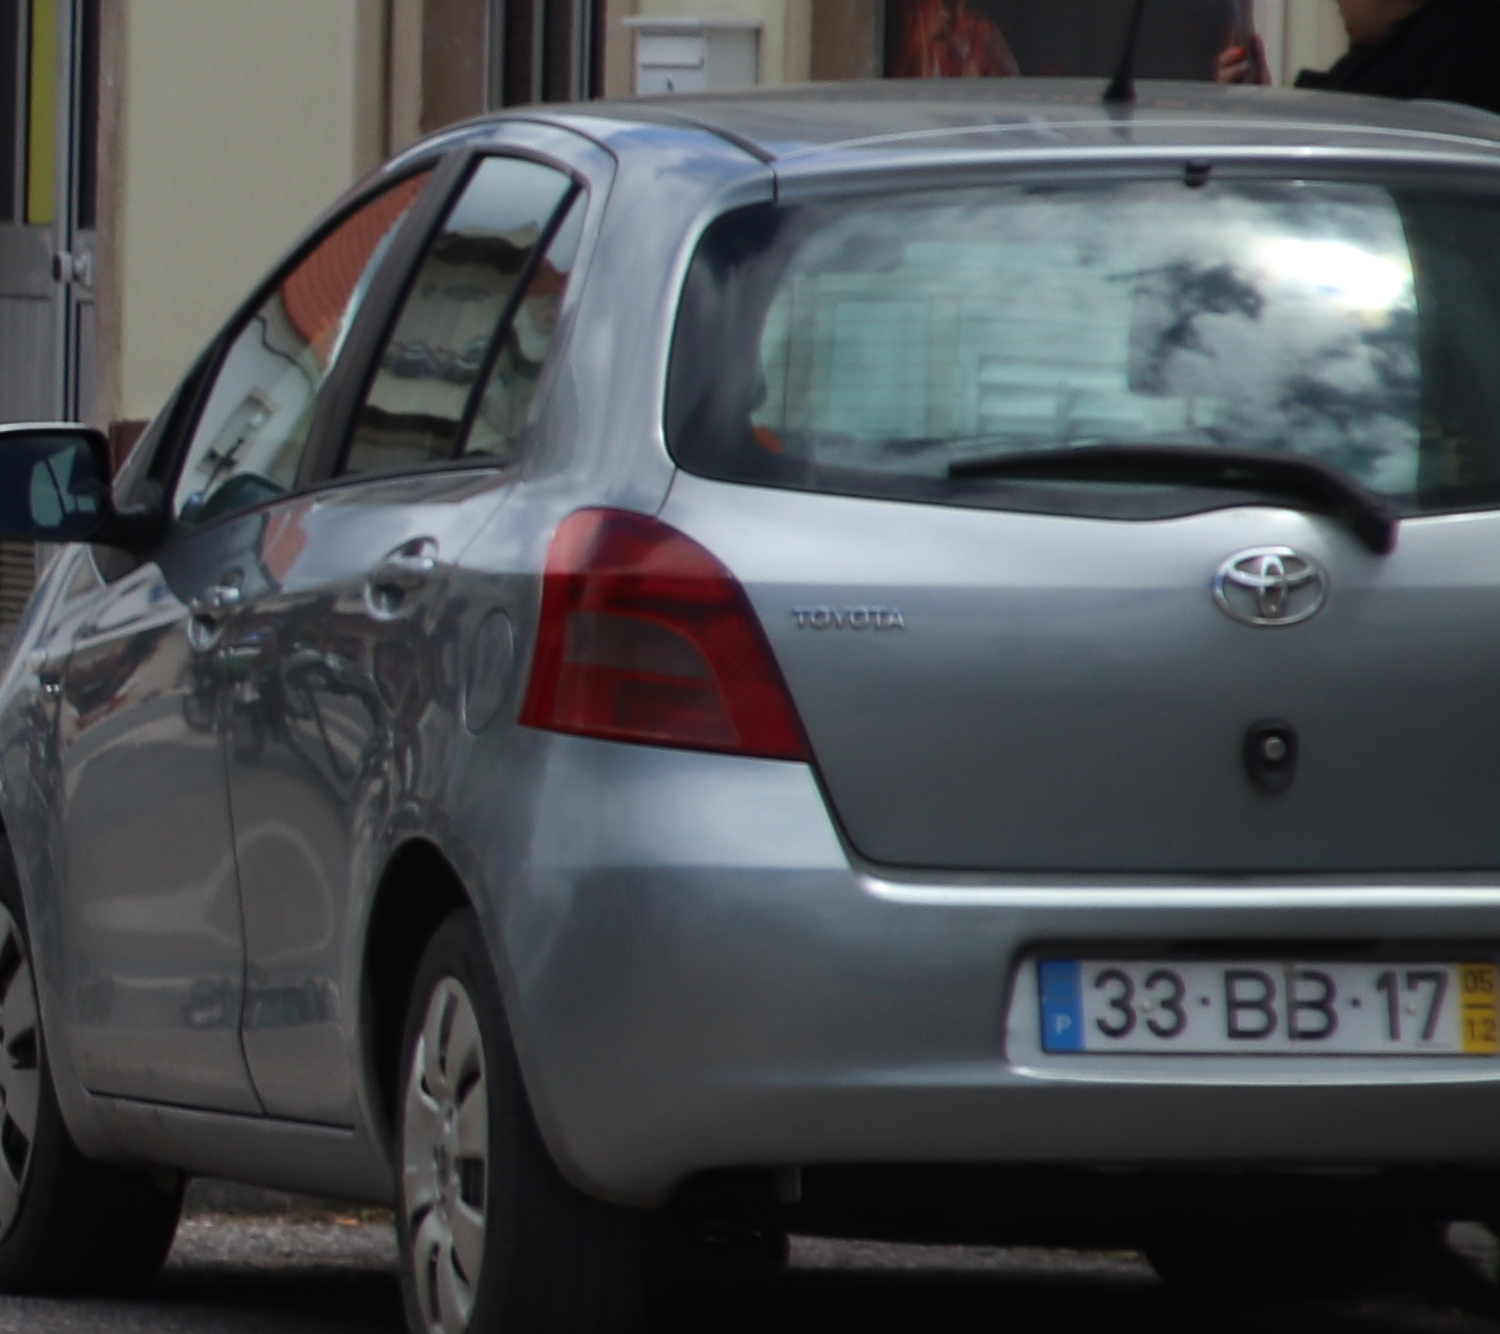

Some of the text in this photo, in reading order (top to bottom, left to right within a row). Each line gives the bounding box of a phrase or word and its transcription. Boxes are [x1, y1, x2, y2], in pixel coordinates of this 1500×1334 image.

[791, 607, 904, 629] TOYOTA
[1464, 969, 1495, 993] 05
[1053, 1014, 1073, 1035] P
[1466, 1017, 1498, 1043] 12
